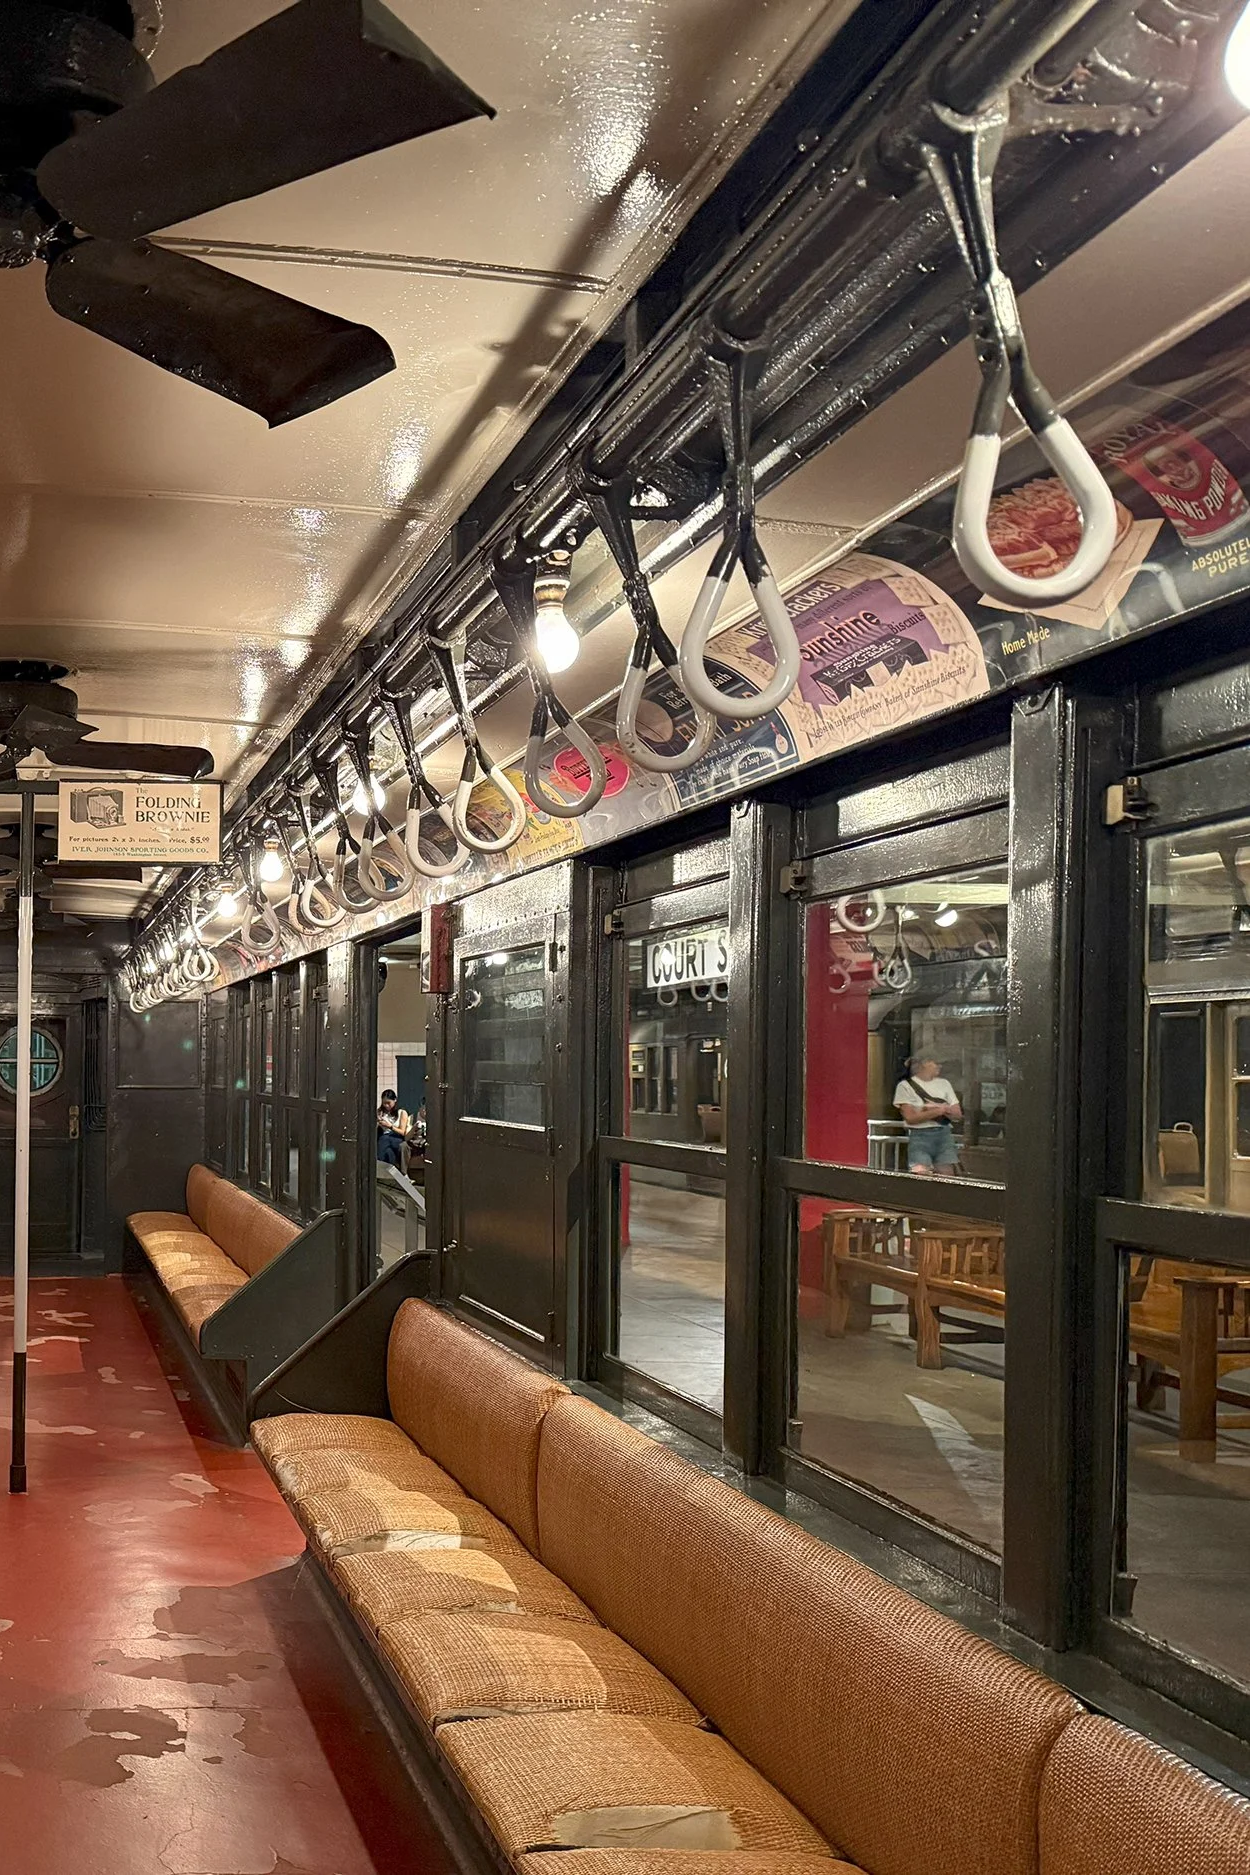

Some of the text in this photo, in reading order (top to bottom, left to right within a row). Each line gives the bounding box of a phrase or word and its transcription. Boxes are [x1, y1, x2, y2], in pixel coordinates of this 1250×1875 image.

[1191, 536, 1250, 572] ABSOLUTEL
[1208, 552, 1250, 578] PURE
[799, 610, 881, 662] Sunshine
[888, 611, 927, 635] Biscuits
[1002, 638, 1026, 656] Home
[912, 680, 940, 695] Sunshine
[940, 666, 967, 683] Biscuits
[135, 796, 201, 809] FOLDING
[135, 810, 211, 823] BROWNIE
[652, 939, 709, 985] COURT
